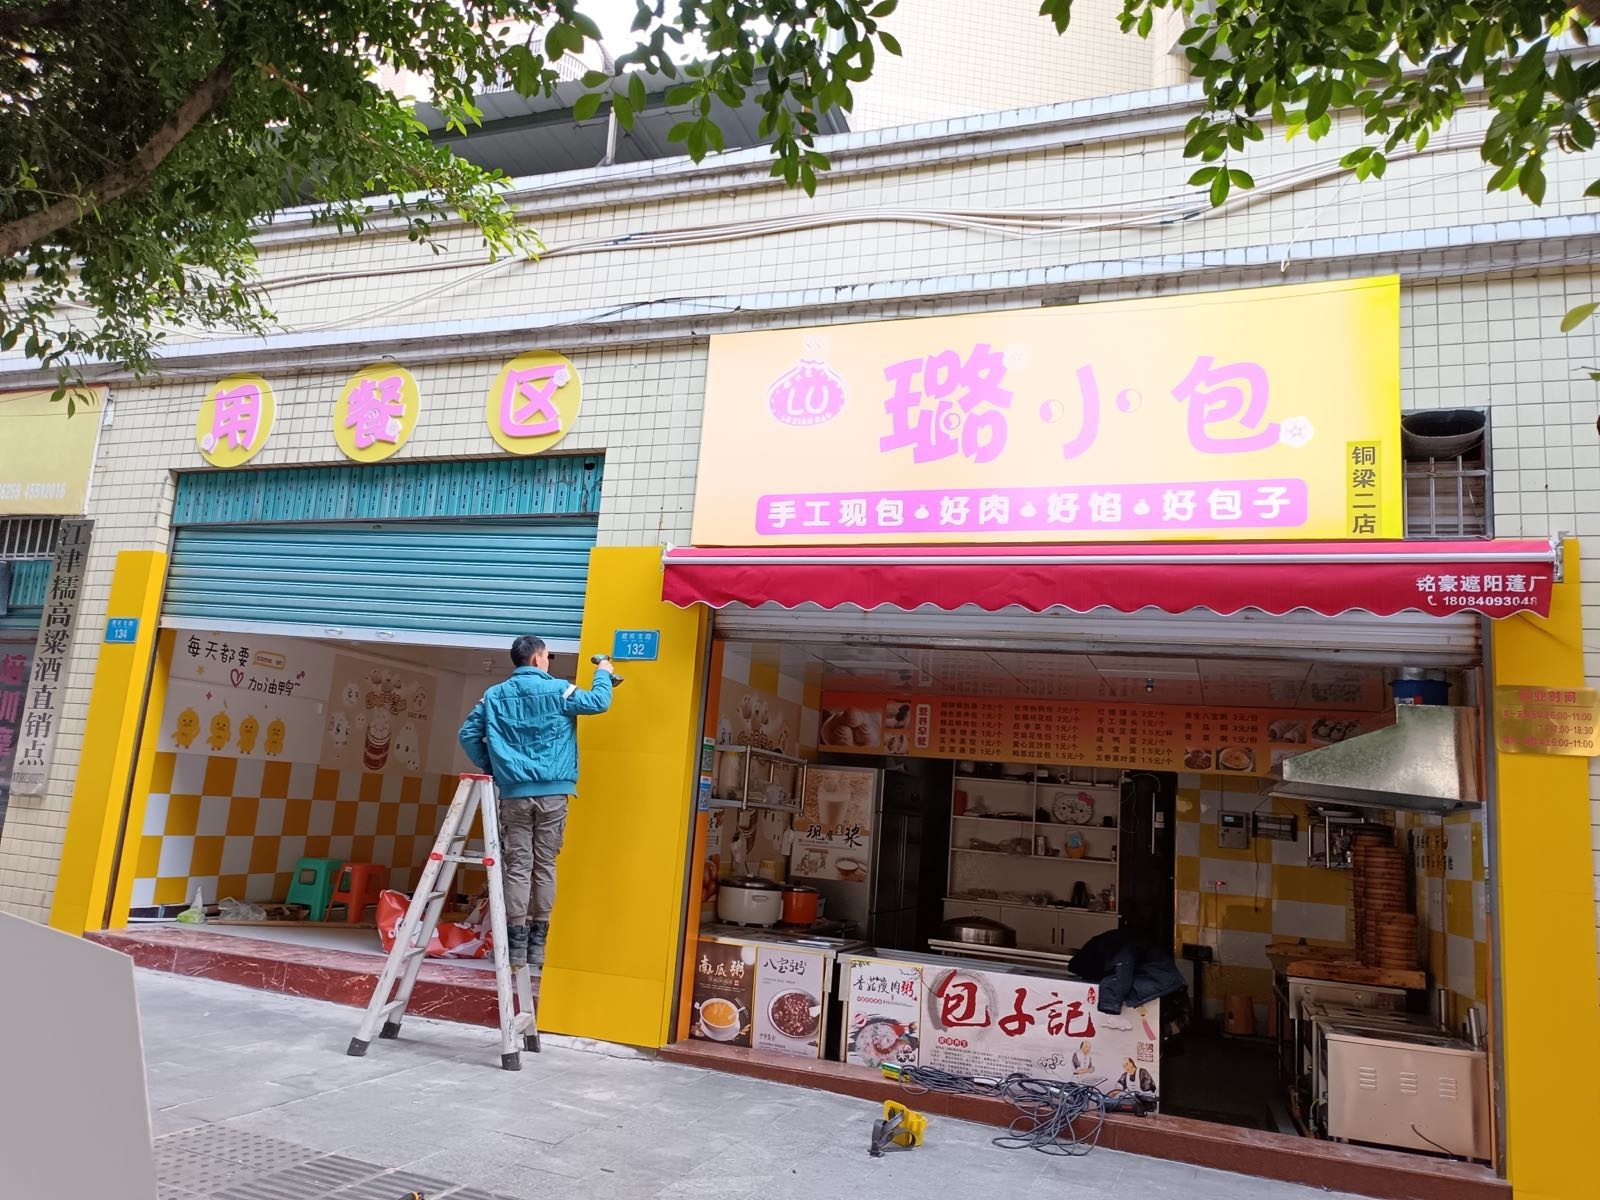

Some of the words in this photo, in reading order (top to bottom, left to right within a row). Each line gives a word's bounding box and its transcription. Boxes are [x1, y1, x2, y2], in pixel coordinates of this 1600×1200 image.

[201, 363, 570, 453] 用餐区
[787, 385, 830, 415] LU
[880, 342, 1287, 464] 璐小包
[1352, 446, 1376, 534] 铜梁二店
[767, 498, 905, 528] 手工现包
[939, 496, 1011, 526] 好肉
[1046, 491, 1123, 525] 好馅
[1161, 486, 1291, 521] 好包子
[1416, 574, 1547, 592] 铭豪遮阳蓬厂
[19, 522, 89, 767] 江津糯高粱酒直销点
[115, 629, 127, 639] 134
[627, 643, 645, 656] 132
[187, 633, 250, 668] 每天都要
[699, 954, 746, 979] 南瓜粥
[763, 956, 807, 976] 八宝粥
